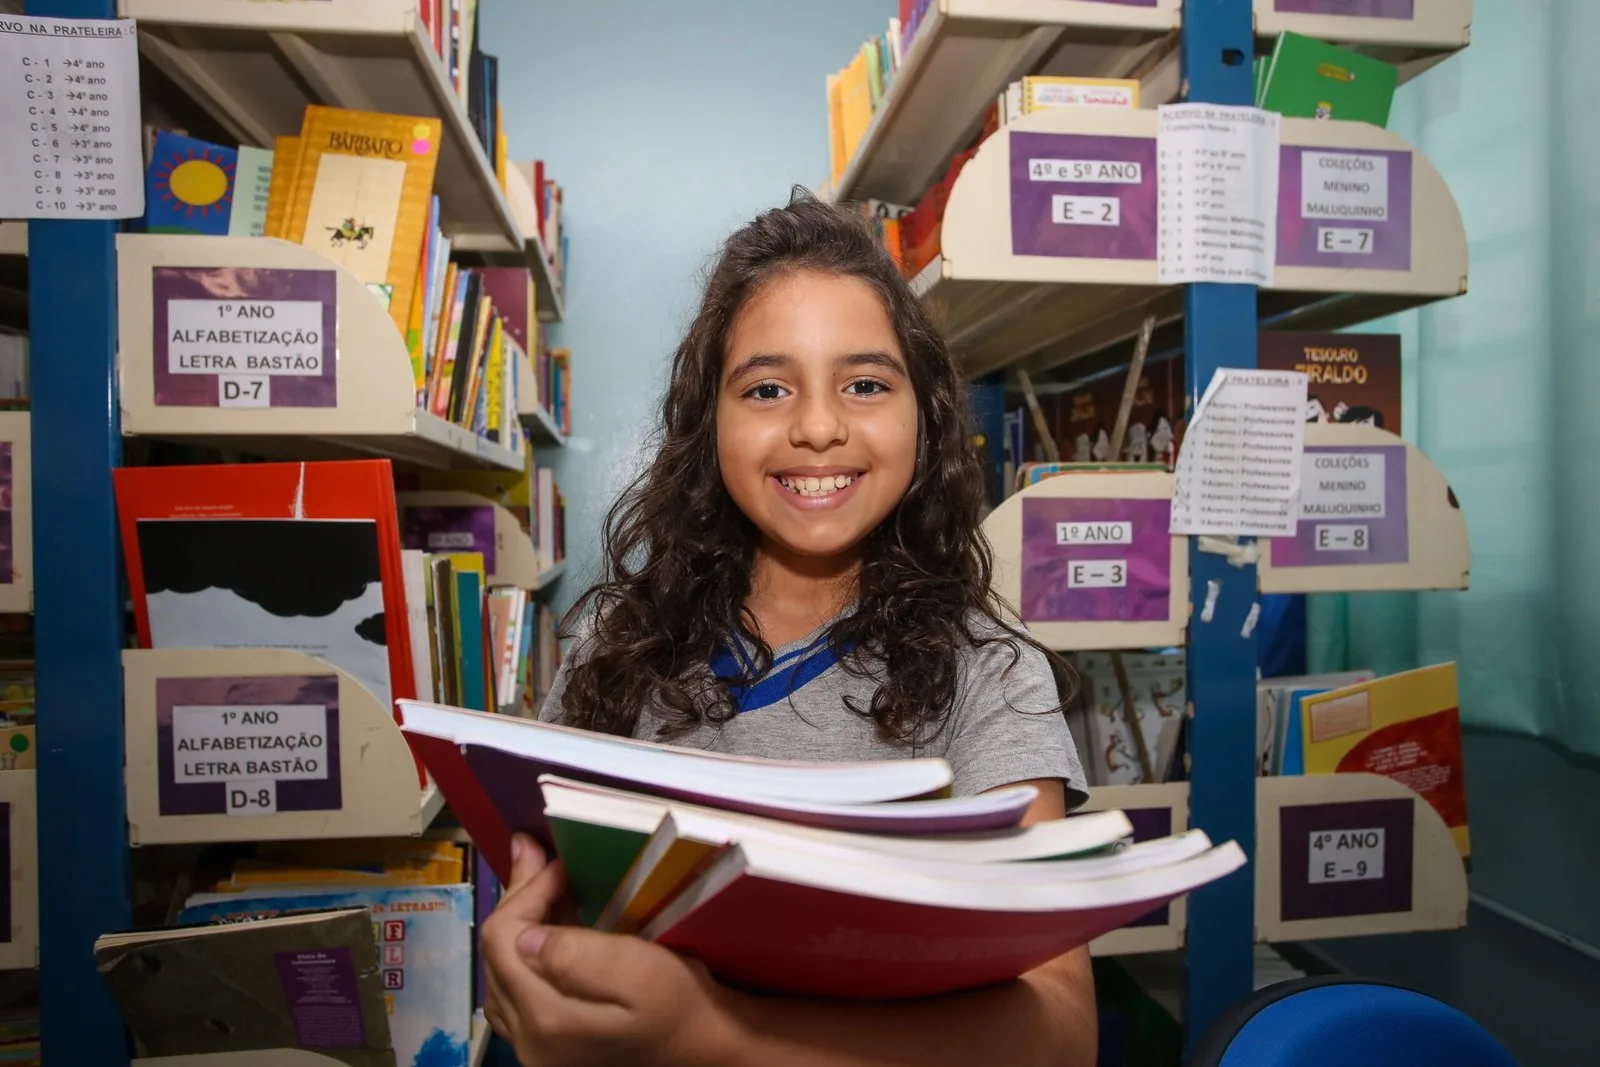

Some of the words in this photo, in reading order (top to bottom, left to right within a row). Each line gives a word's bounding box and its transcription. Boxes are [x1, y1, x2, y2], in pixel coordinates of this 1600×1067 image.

[30, 25, 47, 34] NA
[54, 26, 122, 36] PRATELEIRA
[22, 58, 30, 66] C
[45, 59, 49, 67] 1
[86, 61, 105, 69] ano
[25, 75, 32, 83] C
[46, 75, 52, 83] 2
[88, 77, 106, 85] ano
[27, 91, 34, 99] C
[29, 107, 36, 115] C
[50, 108, 56, 116] 4
[31, 123, 38, 131] C
[52, 124, 57, 132] 5
[32, 139, 39, 147] C
[53, 140, 59, 148] 6
[33, 155, 41, 163] C
[1319, 156, 1374, 173] COLEÇÕES
[35, 171, 42, 179] C
[55, 171, 61, 179] 8
[1033, 164, 1052, 178] 4º
[1059, 167, 1067, 178] e
[1074, 165, 1091, 178] 5º
[1098, 165, 1137, 179] ANO
[35, 186, 43, 194] C
[98, 188, 116, 196] ano
[1324, 181, 1370, 193] MENINO
[36, 201, 43, 210] C
[54, 202, 65, 210] 10
[1064, 203, 1073, 219] E
[1101, 204, 1112, 221] 2
[1307, 203, 1384, 217] MALUQUINHO
[1324, 232, 1333, 248] E
[1358, 233, 1368, 249] 7
[217, 305, 232, 318] 1º
[237, 306, 275, 318] ANO
[173, 327, 318, 346] ALFABETIZAÇÃO
[180, 355, 236, 369] LETRA
[247, 353, 318, 370] BASTÃO
[1304, 347, 1359, 362] TESOURO
[224, 382, 263, 400] D-7
[1315, 455, 1369, 471] COLEÇÕES
[1320, 481, 1366, 491] MENINO
[1303, 504, 1381, 515] MALUQUINHO
[1061, 526, 1079, 541] 1º
[1084, 526, 1123, 541] ANO
[1320, 529, 1329, 546] E
[1353, 530, 1364, 546] 8
[1074, 567, 1083, 583] E
[1111, 566, 1122, 582] 3
[222, 712, 236, 725] 1º
[241, 712, 278, 725] ANO
[178, 732, 322, 752] ALFABETIZAÇÃO
[184, 763, 241, 776] LETRA
[247, 757, 318, 774] BASTÃO
[231, 789, 270, 808] D-8
[1313, 834, 1331, 850] 4º
[1337, 832, 1378, 849] ANO
[1324, 862, 1336, 878] E
[1357, 860, 1367, 876] 9
[390, 925, 400, 939] F
[389, 949, 399, 962] L
[388, 973, 398, 986] R
